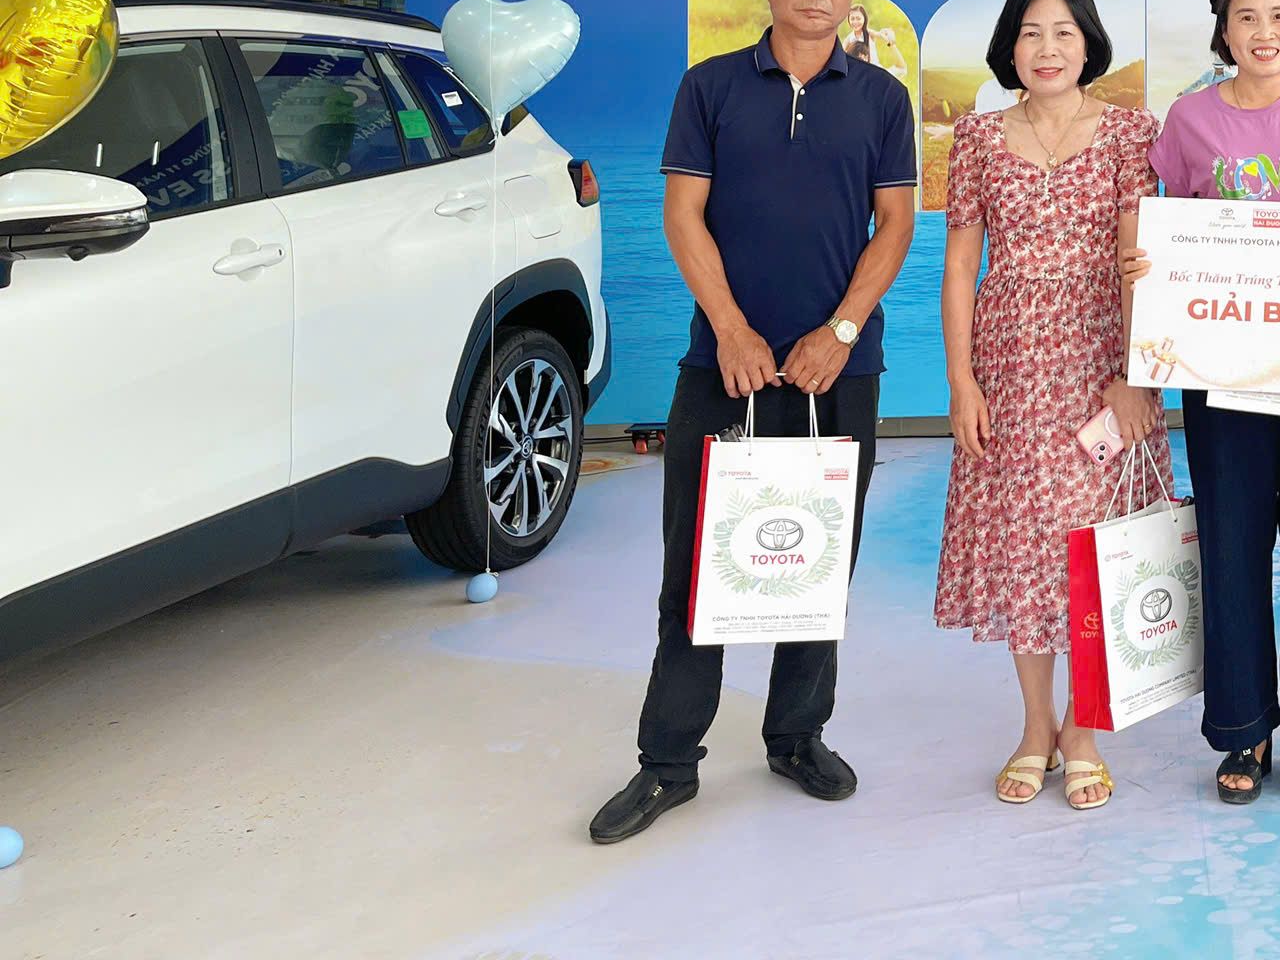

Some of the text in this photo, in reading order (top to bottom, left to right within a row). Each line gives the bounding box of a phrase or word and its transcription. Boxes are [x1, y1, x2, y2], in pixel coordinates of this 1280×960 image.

[1171, 234, 1199, 243] CÔNG
[1200, 236, 1210, 244] TY
[1213, 237, 1237, 245] TNHH
[1240, 238, 1275, 247] TOYOTA
[1168, 270, 1193, 283] Bốc
[1196, 271, 1232, 284] Thăm
[1236, 273, 1273, 289] Trúng
[1187, 291, 1252, 322] GIẢI
[750, 554, 805, 565] TOYOTA
[1140, 619, 1178, 641] TOYOTA
